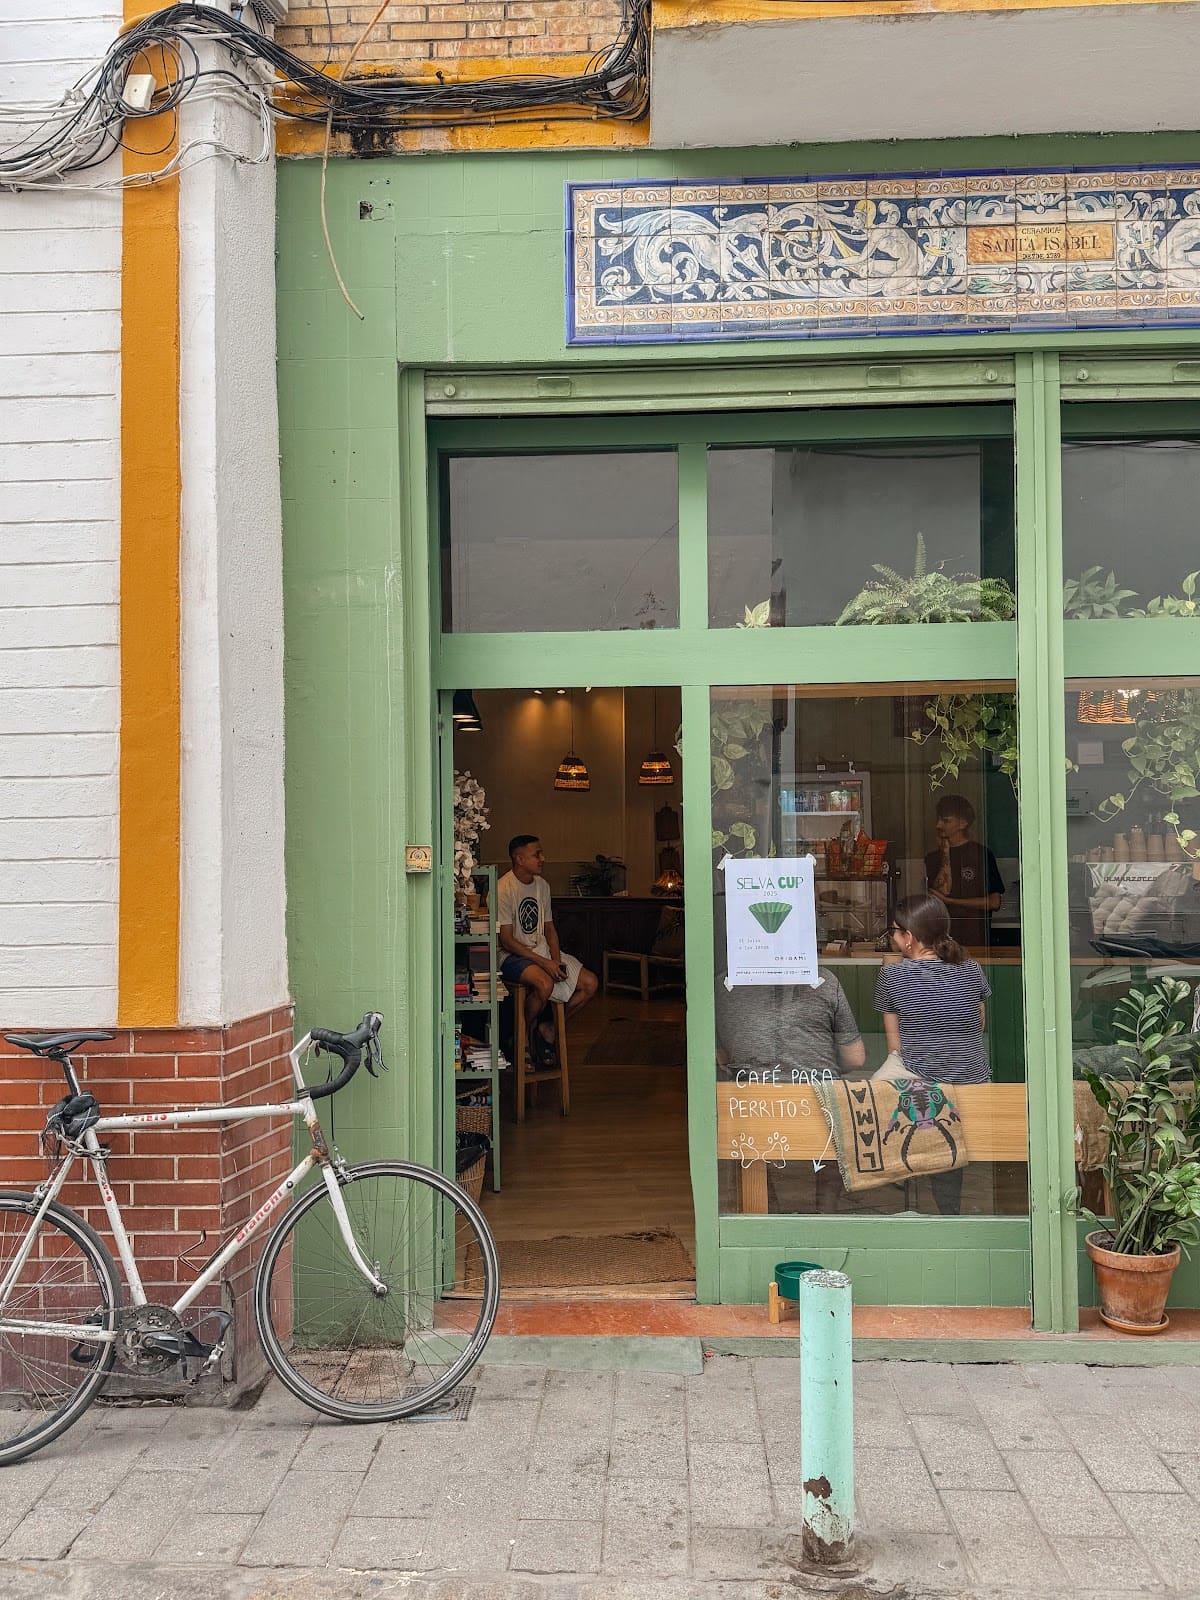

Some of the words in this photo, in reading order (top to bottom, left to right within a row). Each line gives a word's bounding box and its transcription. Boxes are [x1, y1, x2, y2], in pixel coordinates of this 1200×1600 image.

[982, 237, 1037, 254] SANTA
[1044, 235, 1101, 251] ISABEL
[736, 877, 776, 890] SELVA
[777, 876, 804, 889] CUP
[735, 1064, 783, 1089] CAFÉ
[791, 1068, 834, 1087] PARA
[729, 1097, 811, 1120] PERRITOS
